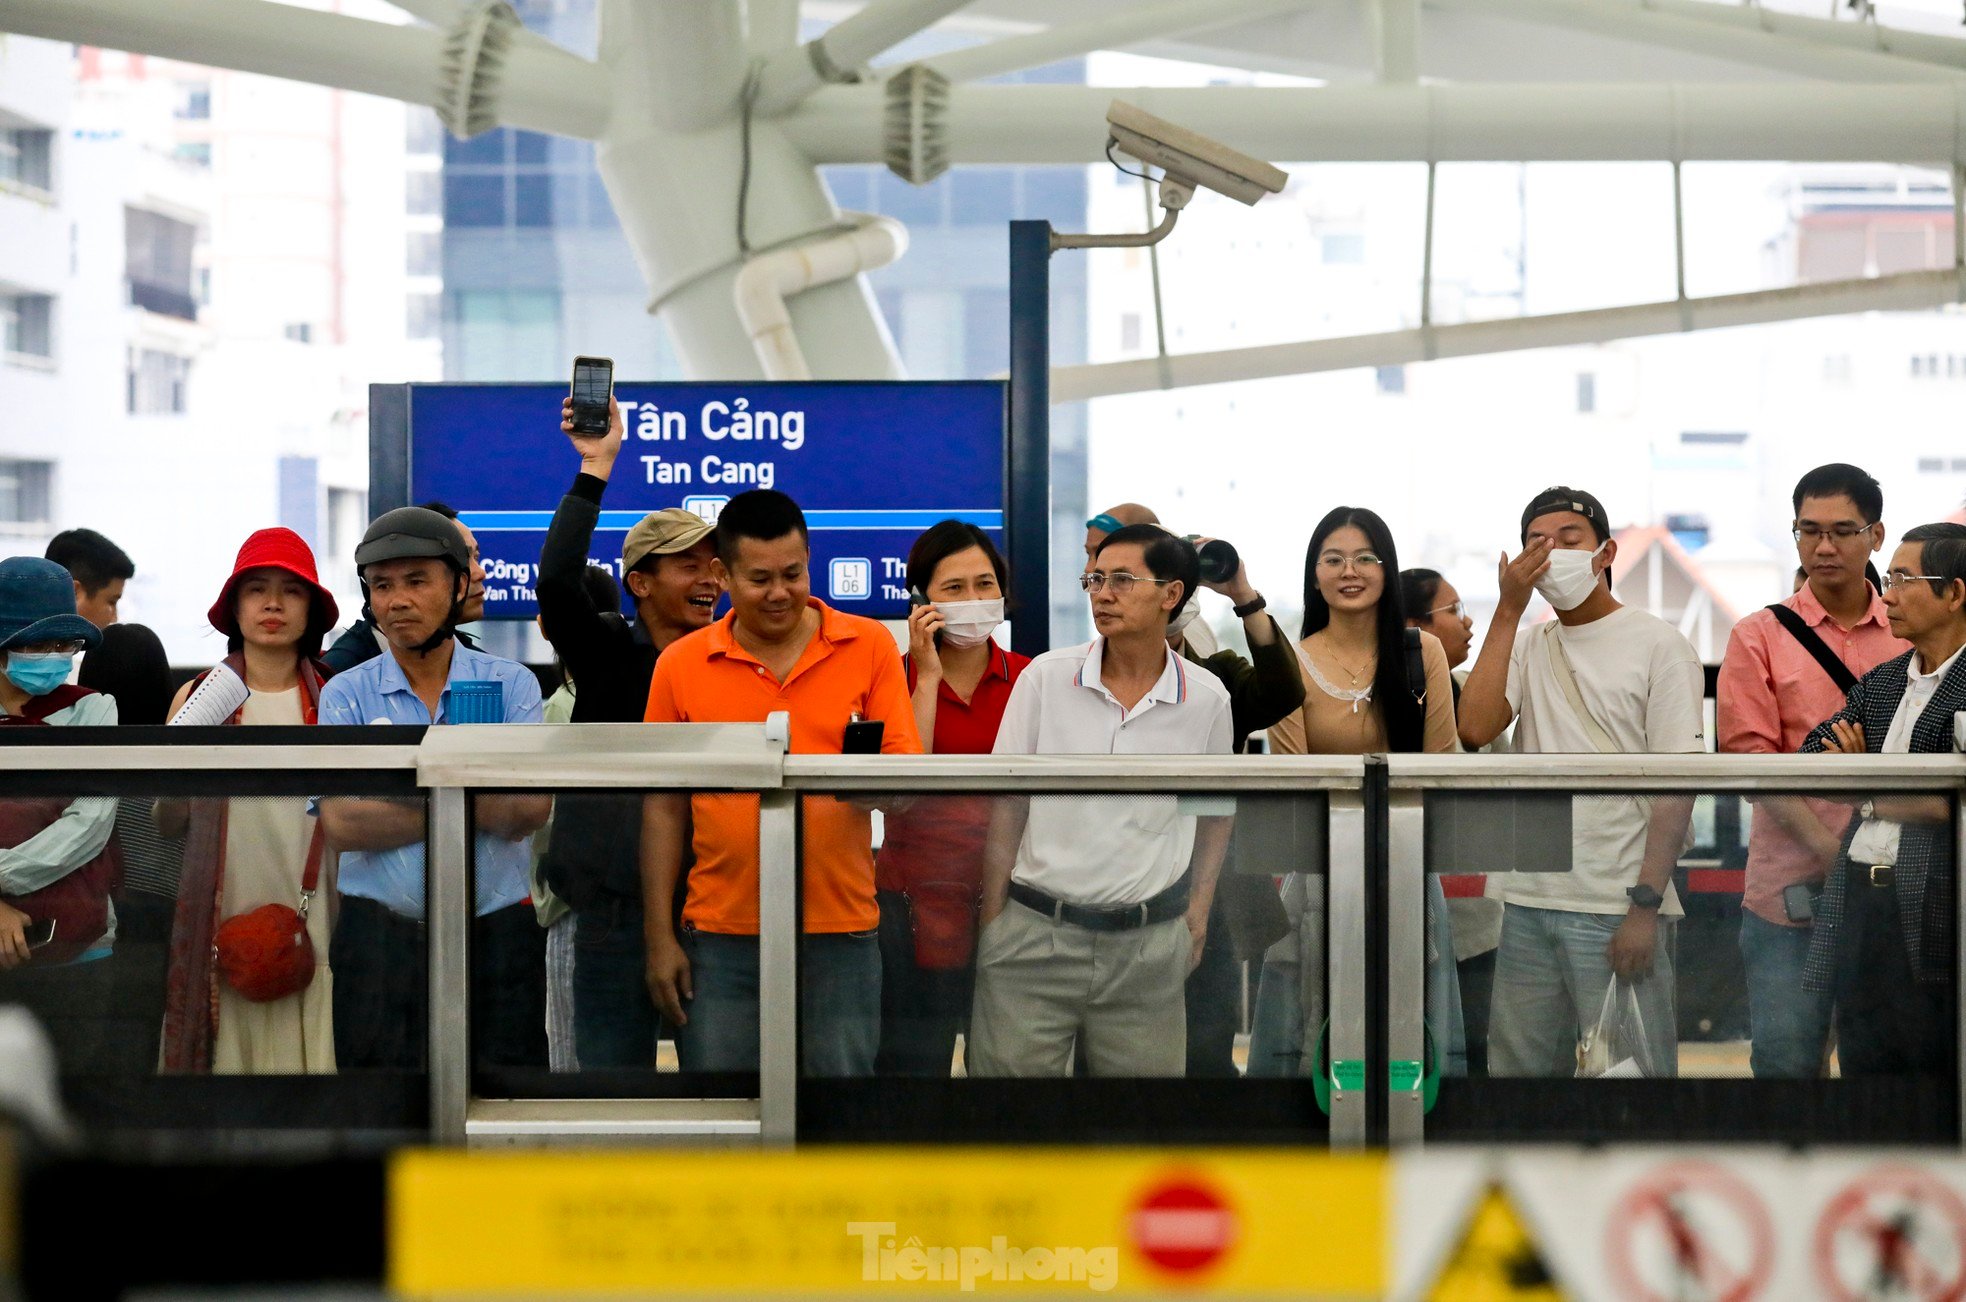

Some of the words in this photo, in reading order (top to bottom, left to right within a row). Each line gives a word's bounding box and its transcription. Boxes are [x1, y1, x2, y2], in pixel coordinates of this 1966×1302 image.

[617, 401, 687, 441] Tân
[701, 397, 805, 451] Cảng
[640, 455, 692, 485] Tan
[701, 455, 775, 490] Cang
[699, 503, 716, 519] L1
[480, 558, 530, 585] Công
[843, 564, 859, 578] L1
[881, 557, 907, 578] Th
[511, 585, 538, 601] Tha
[842, 579, 859, 593] 06
[881, 584, 911, 600] Tha
